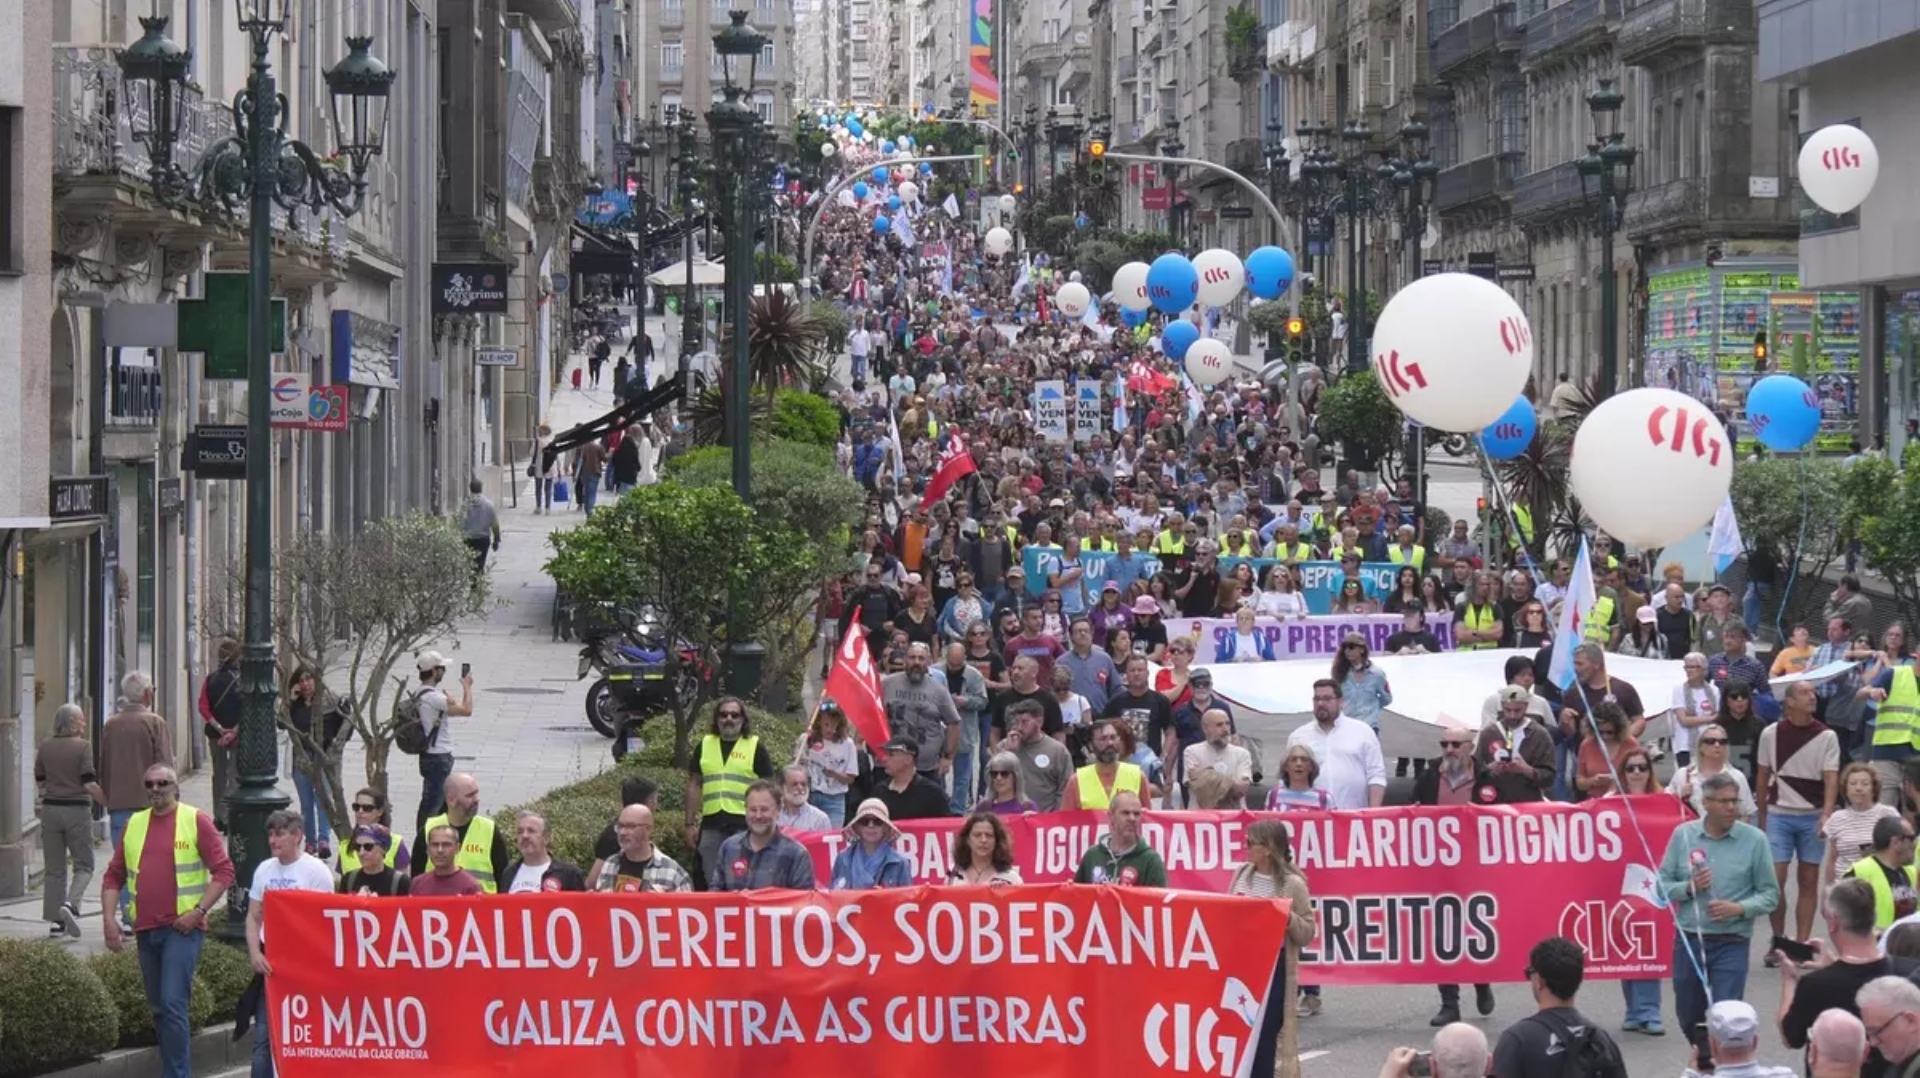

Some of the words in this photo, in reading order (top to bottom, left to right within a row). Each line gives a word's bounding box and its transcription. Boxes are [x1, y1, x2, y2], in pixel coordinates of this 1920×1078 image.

[1822, 147, 1860, 170] CIG
[1204, 266, 1230, 284] CIG
[1137, 285, 1147, 299] CI
[1151, 284, 1171, 299] CIG
[478, 352, 514, 362] ALE-HOP
[1202, 354, 1221, 370] CIG
[1376, 350, 1428, 399] IG
[1039, 400, 1052, 409] VI
[1078, 400, 1090, 409] VI
[1039, 409, 1064, 418] VEN
[1078, 410, 1099, 418] VEN
[1039, 420, 1058, 429] DA
[1078, 420, 1094, 428] DA
[1495, 423, 1523, 440] CIG
[1647, 405, 1721, 468] CIG
[1477, 810, 1623, 865] DIGNOS
[322, 907, 598, 977] TRABALLO,
[609, 904, 882, 975] DEREITOS,
[894, 892, 1220, 971] SOBERANÍA
[1558, 899, 1657, 962] CIG
[294, 1024, 312, 1044] DE
[321, 995, 428, 1049] MAIO
[484, 997, 626, 1046] GALIZA
[635, 997, 806, 1048] CONTRA
[814, 996, 873, 1044] AS
[884, 994, 1087, 1045] GUERRAS
[1143, 1001, 1238, 1077] CIG
[282, 1047, 296, 1058] DÍA
[297, 1048, 357, 1059] INTERNACIONAL
[358, 1049, 369, 1059] DA
[370, 1049, 394, 1060] CLASE
[395, 1049, 429, 1060] OBREIRA
